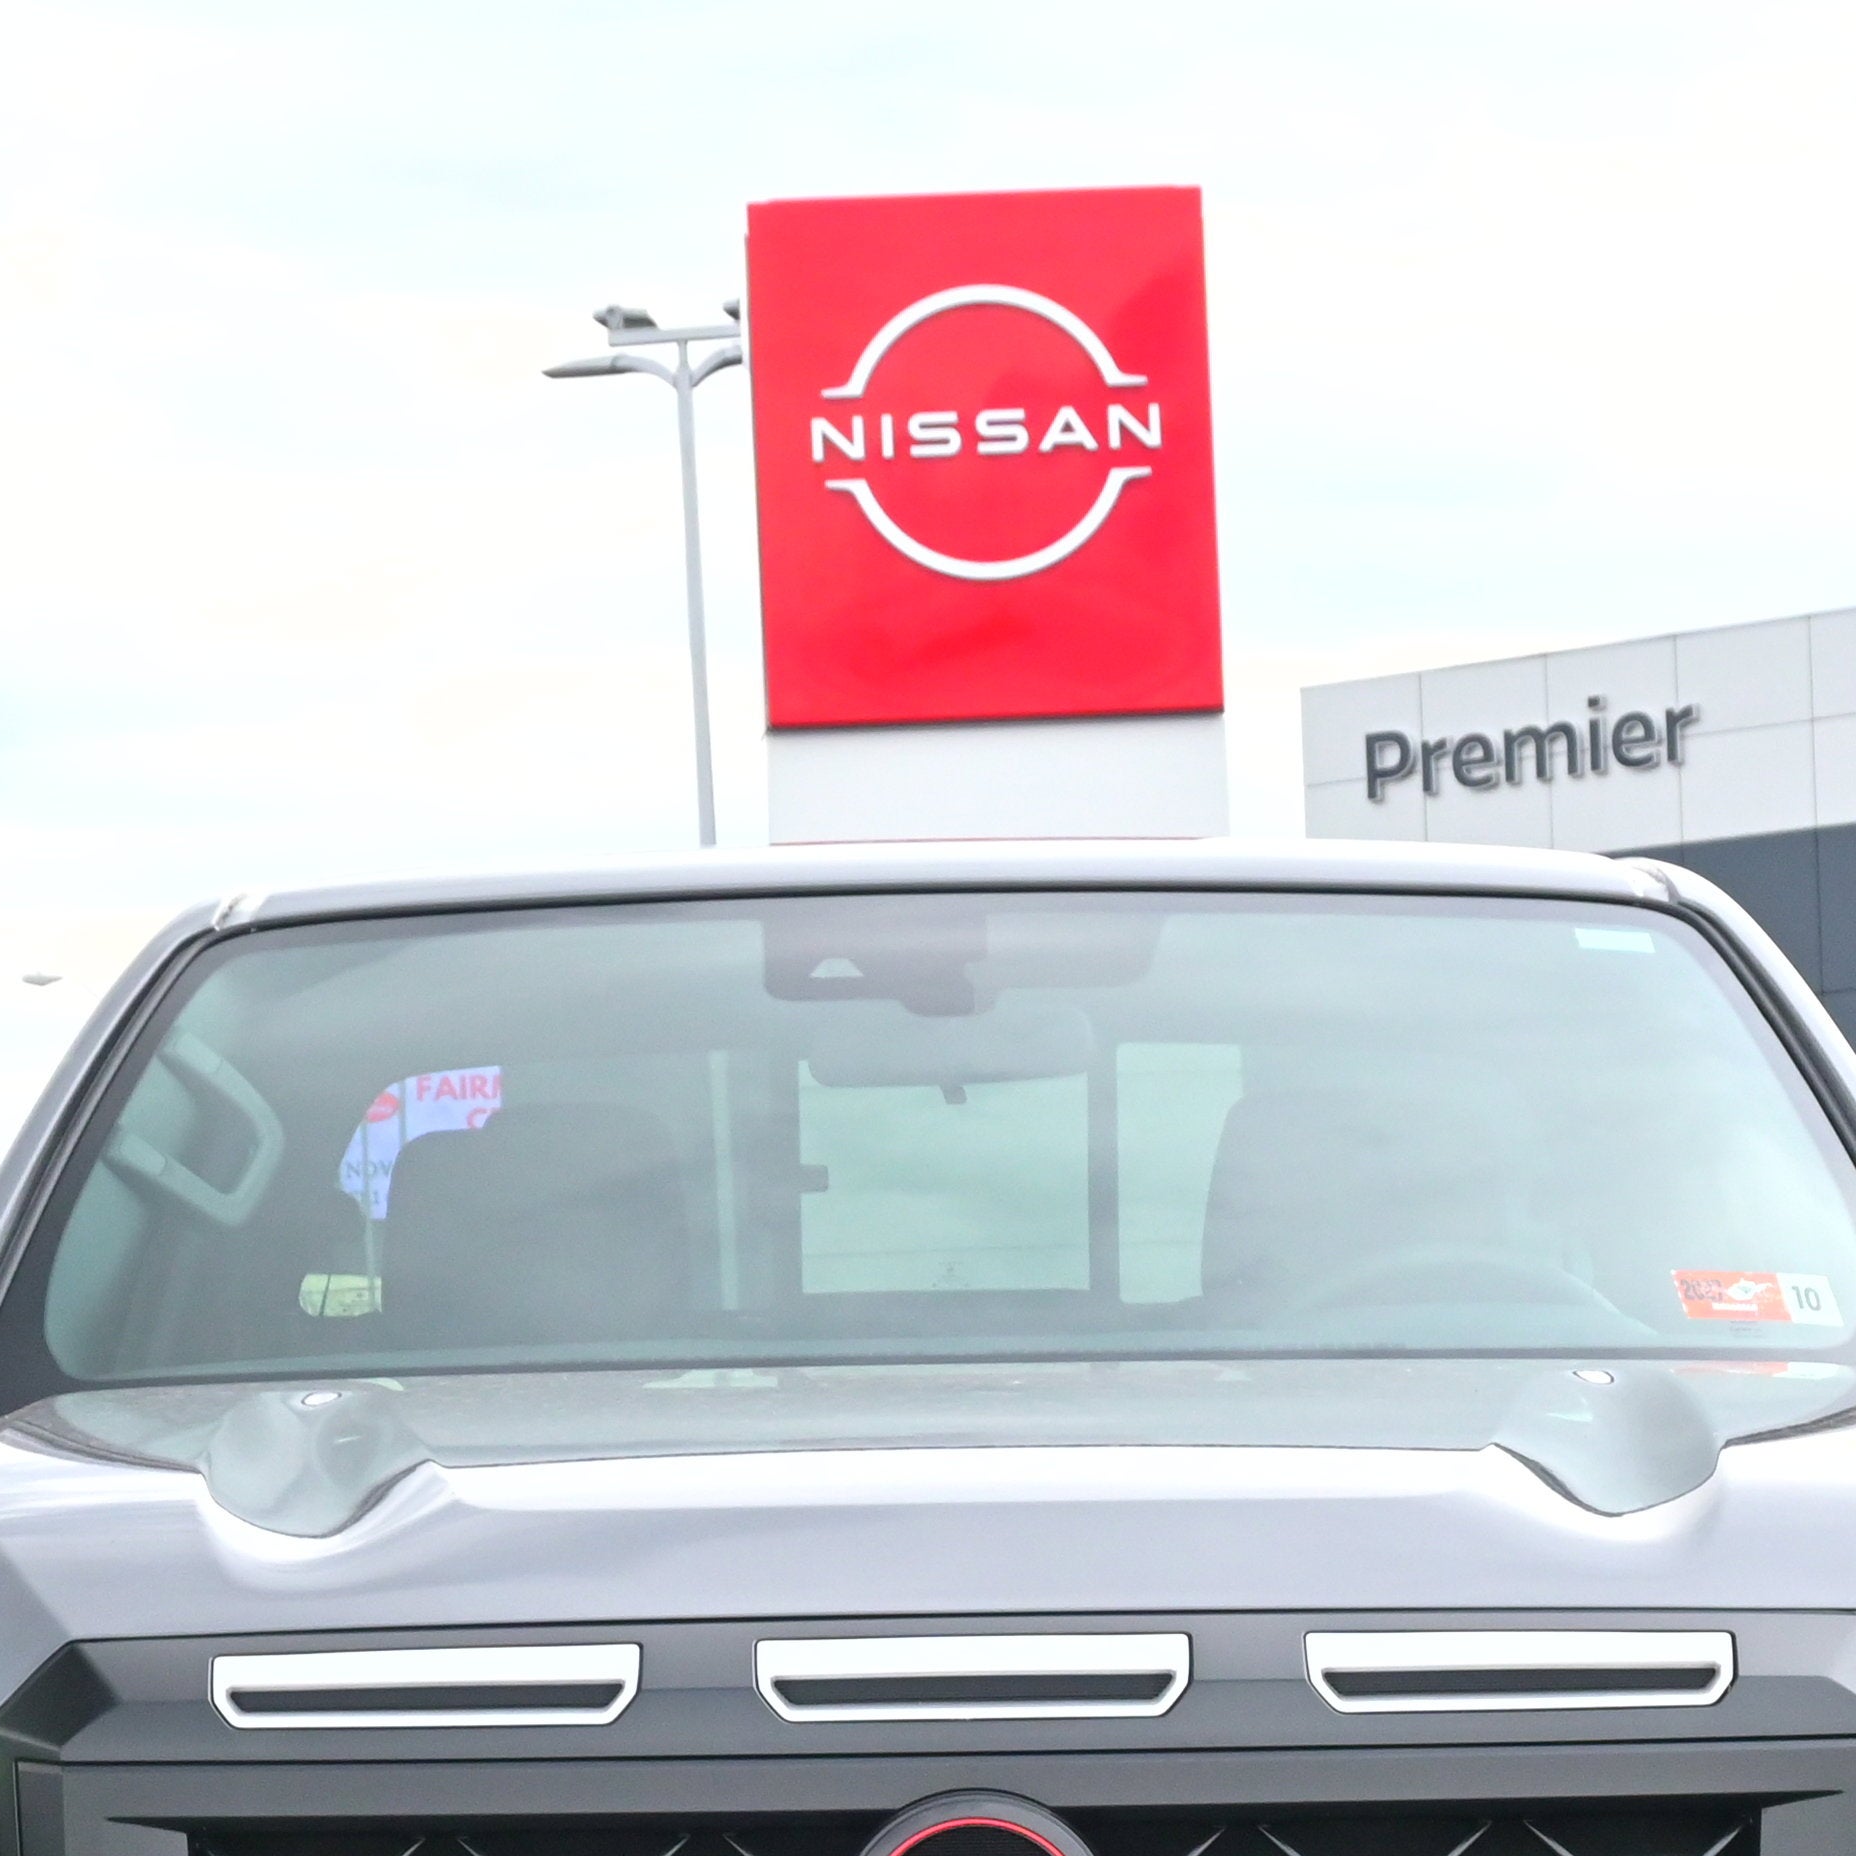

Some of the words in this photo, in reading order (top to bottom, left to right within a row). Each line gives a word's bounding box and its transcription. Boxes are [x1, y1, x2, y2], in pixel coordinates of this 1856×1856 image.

[810, 402, 1162, 462] NISSAN
[1365, 694, 1698, 800] Premier
[1791, 1285, 1822, 1311] 10
